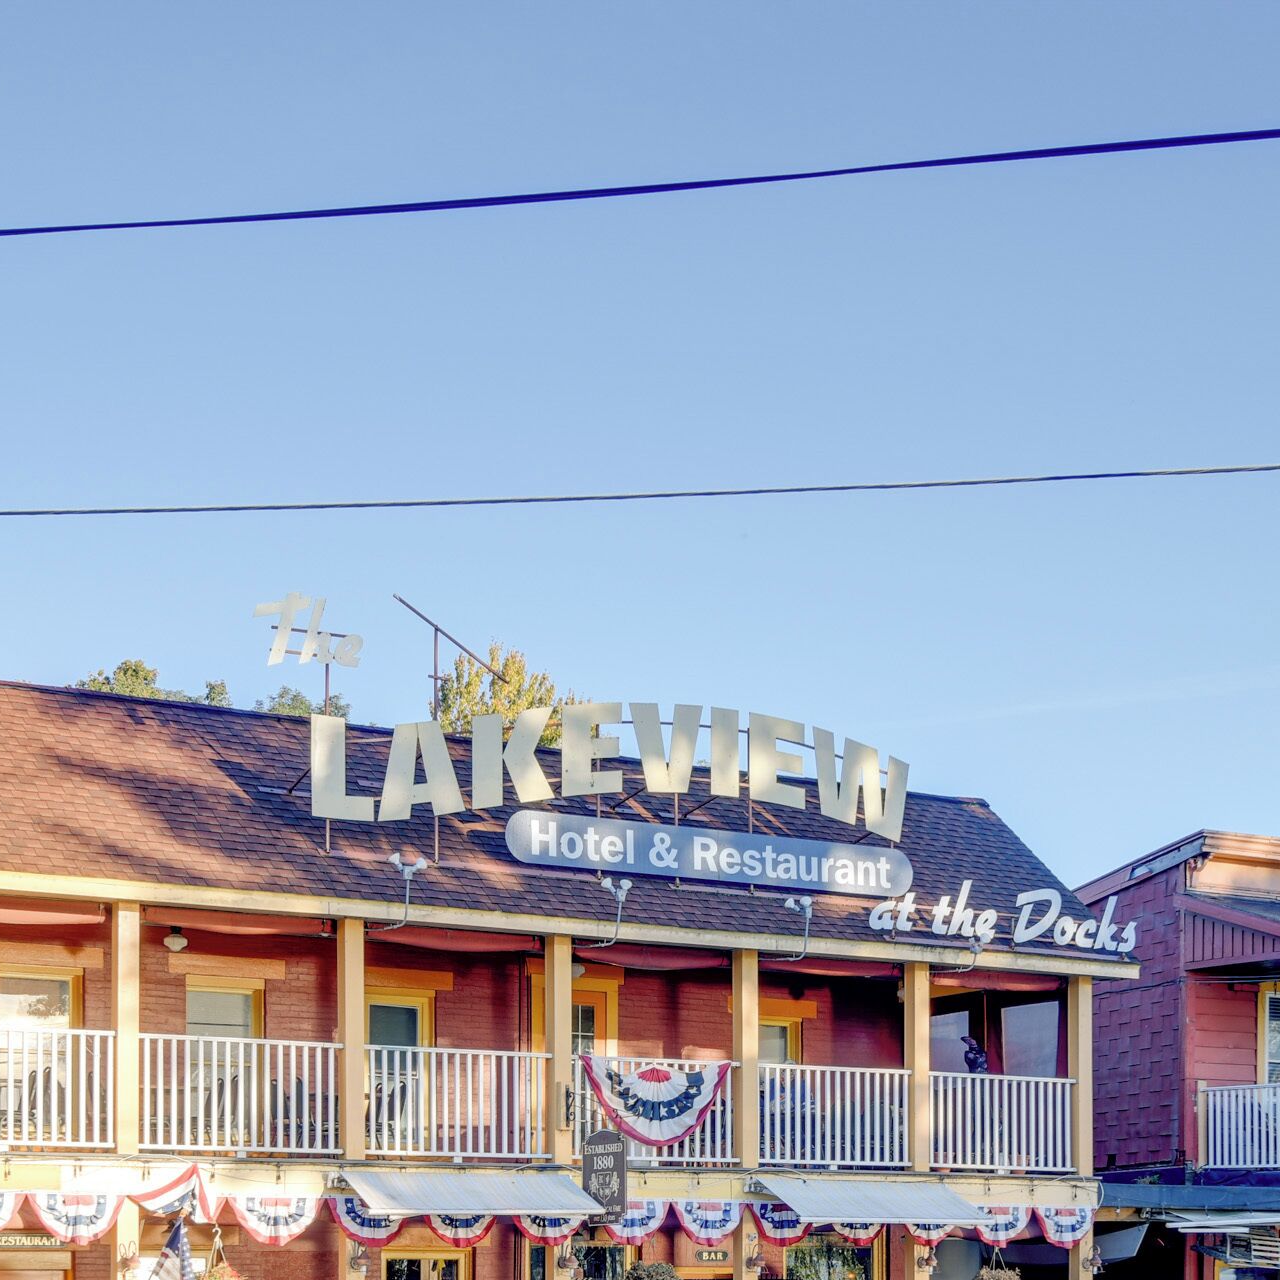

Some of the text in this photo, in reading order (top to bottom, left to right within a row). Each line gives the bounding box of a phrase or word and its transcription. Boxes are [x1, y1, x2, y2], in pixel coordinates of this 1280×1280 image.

[253, 591, 364, 667] The
[311, 702, 909, 843] LAKEVIEW
[531, 819, 891, 888] Hotel & Restaurant
[869, 880, 1137, 952] at the Docks
[585, 1143, 623, 1155] ESTABLISHED
[593, 1155, 614, 1170] 1880
[703, 1252, 723, 1260] BAR
